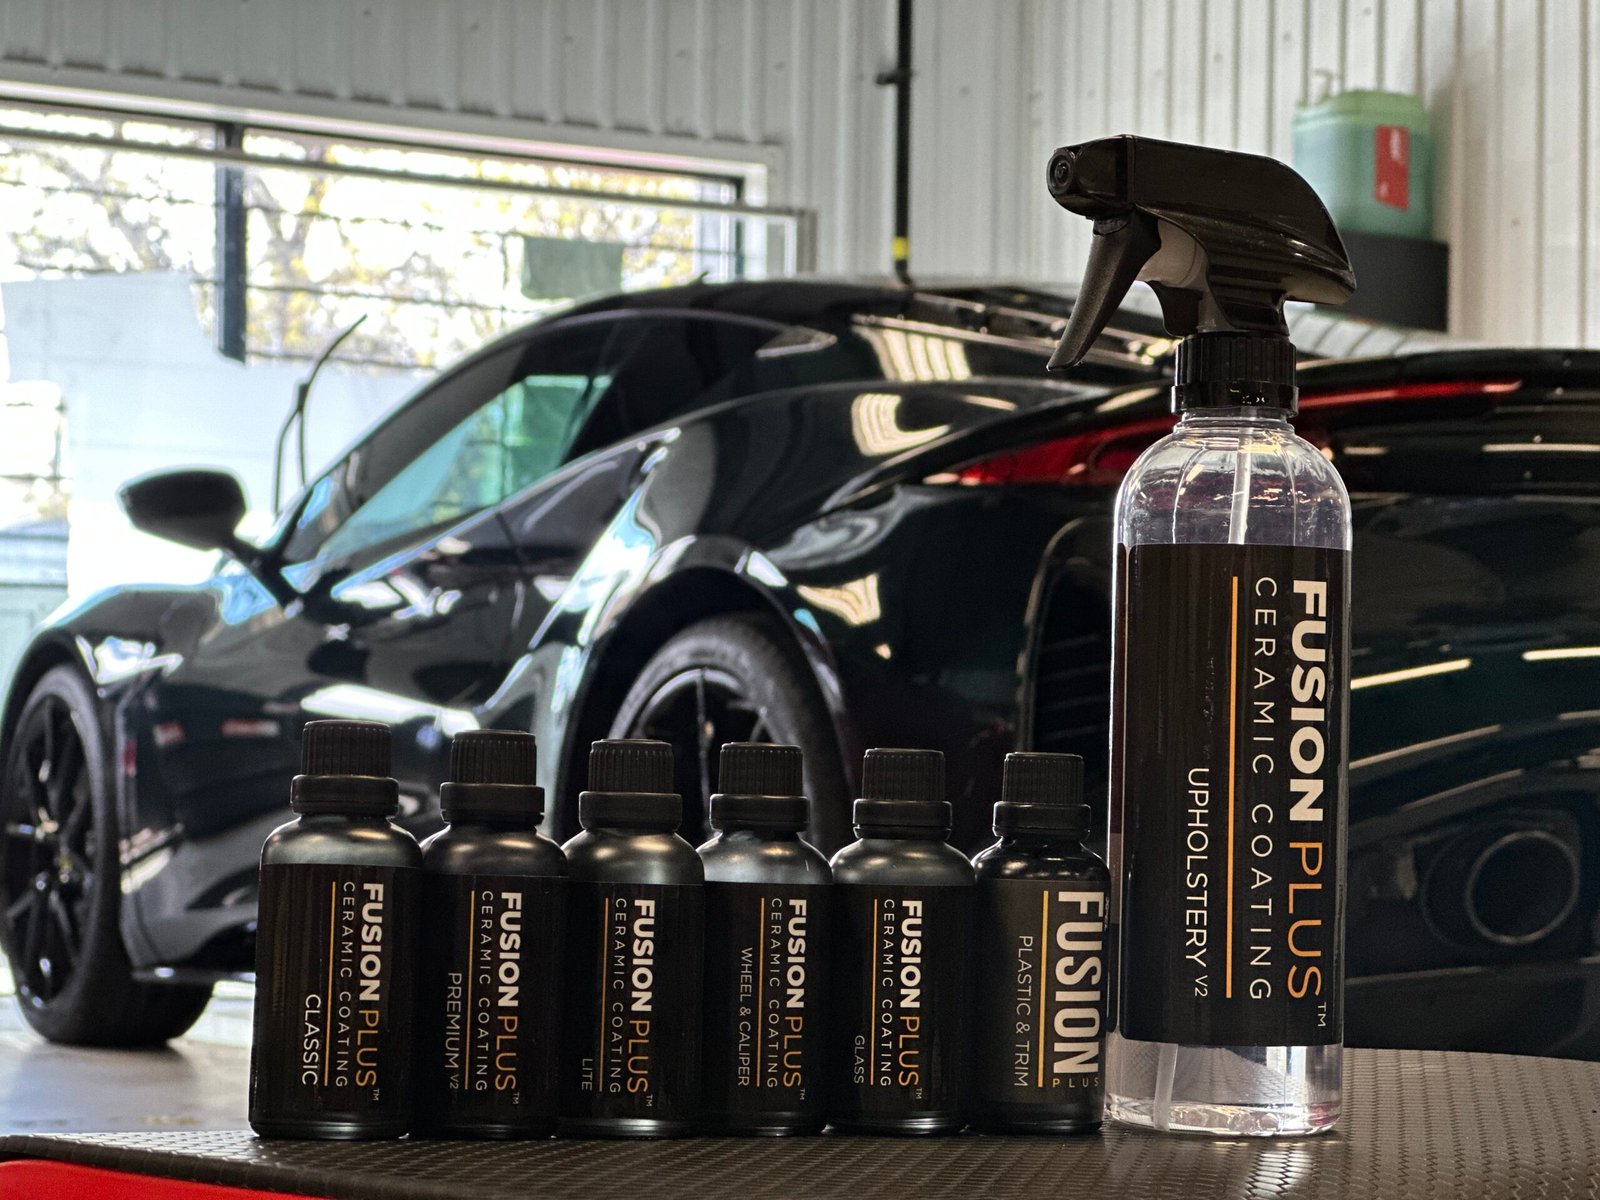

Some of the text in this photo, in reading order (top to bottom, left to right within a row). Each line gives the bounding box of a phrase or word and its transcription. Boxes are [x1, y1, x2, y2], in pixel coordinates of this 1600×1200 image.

[1288, 579, 1328, 821] FUSION
[1249, 576, 1277, 1000] CERAMIC COATING
[1185, 767, 1210, 997] UPHOLSTERY V2
[1287, 842, 1324, 998] PLUS
[335, 882, 356, 1087] CERAMIC COATING
[359, 883, 384, 1001] FUSION
[476, 891, 494, 1091] CERAMIC COATING
[498, 892, 522, 1007] FUSION
[609, 898, 627, 1094] CERAMIC COATING
[631, 899, 655, 1012] FUSION
[767, 898, 782, 1088] CERAMIC COATING
[786, 899, 807, 1009] FUSION
[880, 899, 895, 1086] CERAMIC COATING
[900, 900, 922, 1008] FUSION
[1053, 891, 1104, 1074] FUSION
[302, 994, 321, 1086] CLASSIC
[355, 1009, 379, 1087] PLUS
[445, 973, 462, 1069] PREMIUM
[495, 1015, 518, 1091] PLUS
[627, 1020, 649, 1093] PLUS
[737, 947, 752, 1086] WHEEL & CALIPER
[783, 1016, 803, 1087] PLUS
[854, 1035, 865, 1084] GLASS
[899, 1016, 920, 1086] PLUS
[1014, 935, 1033, 1087] PLASTIC & TRIM
[581, 1058, 593, 1091] LITE
[1052, 1077, 1099, 1088] PLUS
